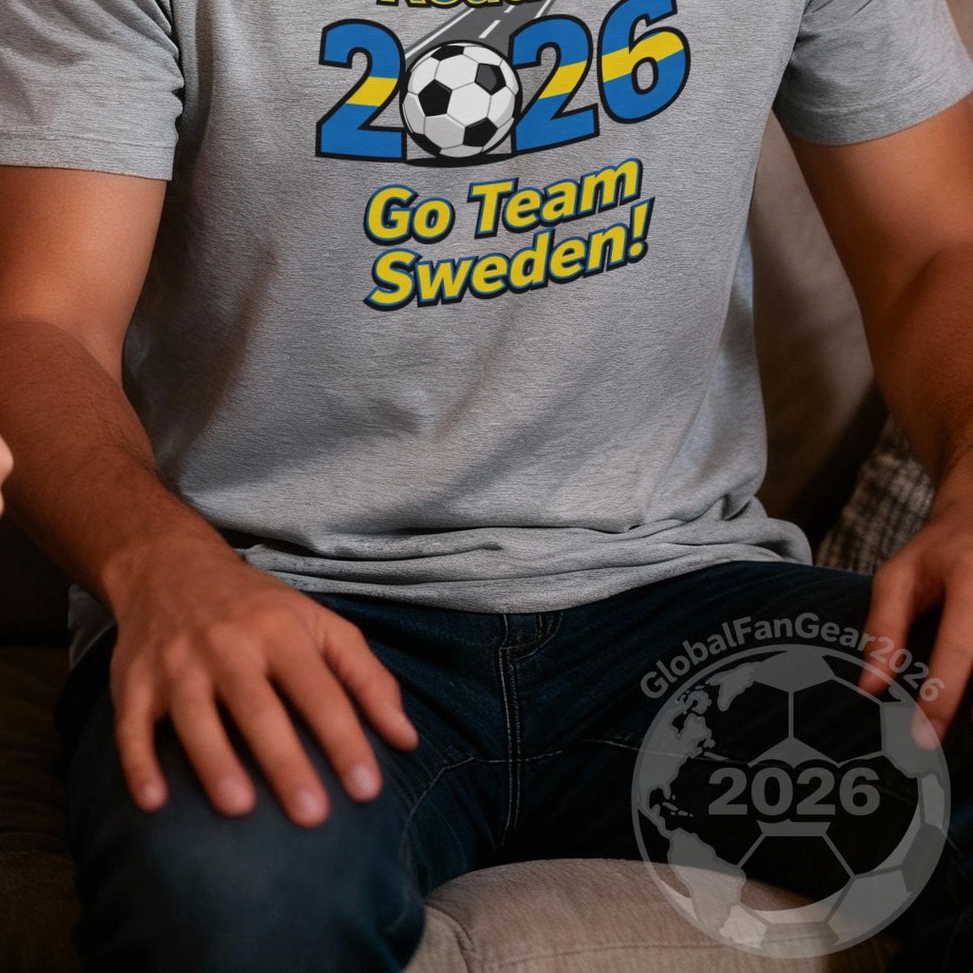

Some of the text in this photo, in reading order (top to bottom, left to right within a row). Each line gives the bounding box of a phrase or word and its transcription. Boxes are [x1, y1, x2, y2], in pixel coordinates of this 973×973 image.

[364, 157, 644, 245] Go Team
[363, 196, 655, 312] Sweden!
